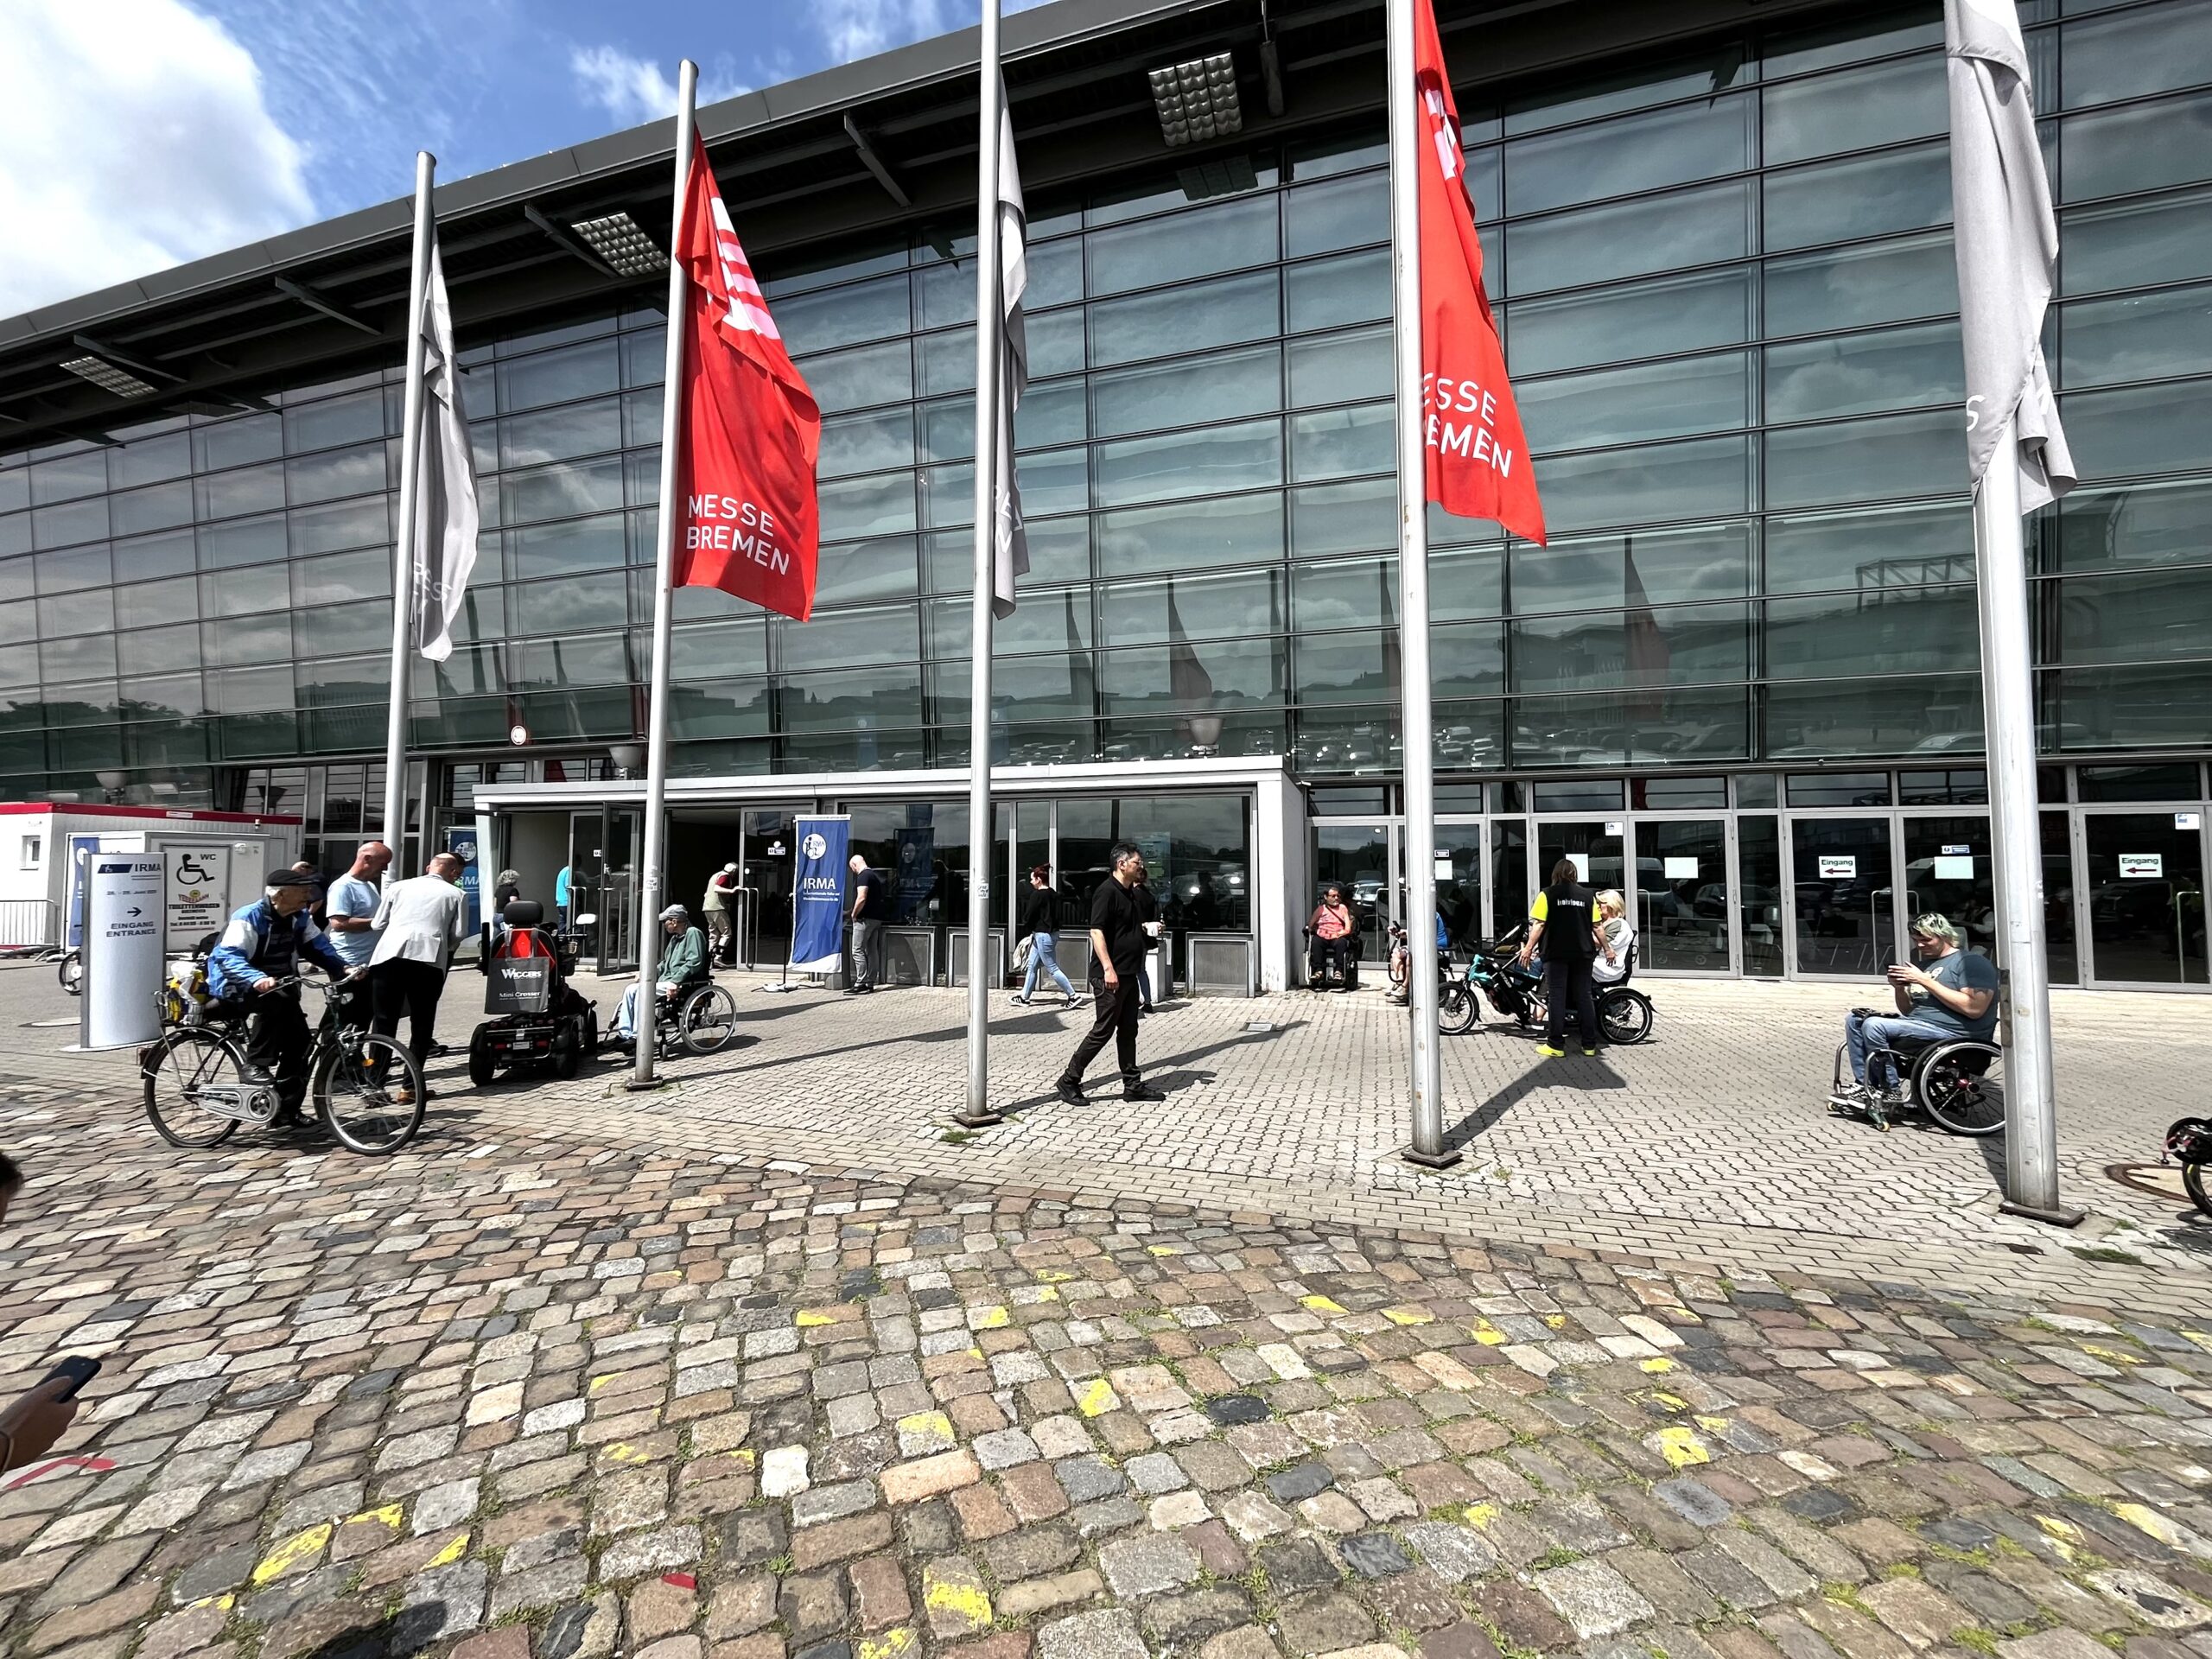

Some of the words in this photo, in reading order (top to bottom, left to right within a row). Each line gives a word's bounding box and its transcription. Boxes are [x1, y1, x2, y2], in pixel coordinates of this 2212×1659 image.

[1423, 372, 1497, 427] ESSE
[1424, 414, 1512, 478] EMEN
[688, 494, 774, 537] MESSE
[686, 525, 790, 575] BREMEN
[135, 863, 162, 872] IRMA
[804, 877, 836, 890] IRMA
[111, 921, 155, 930] EINGANG
[106, 929, 157, 938] ENTRANCE
[501, 968, 542, 979] WIGGERS
